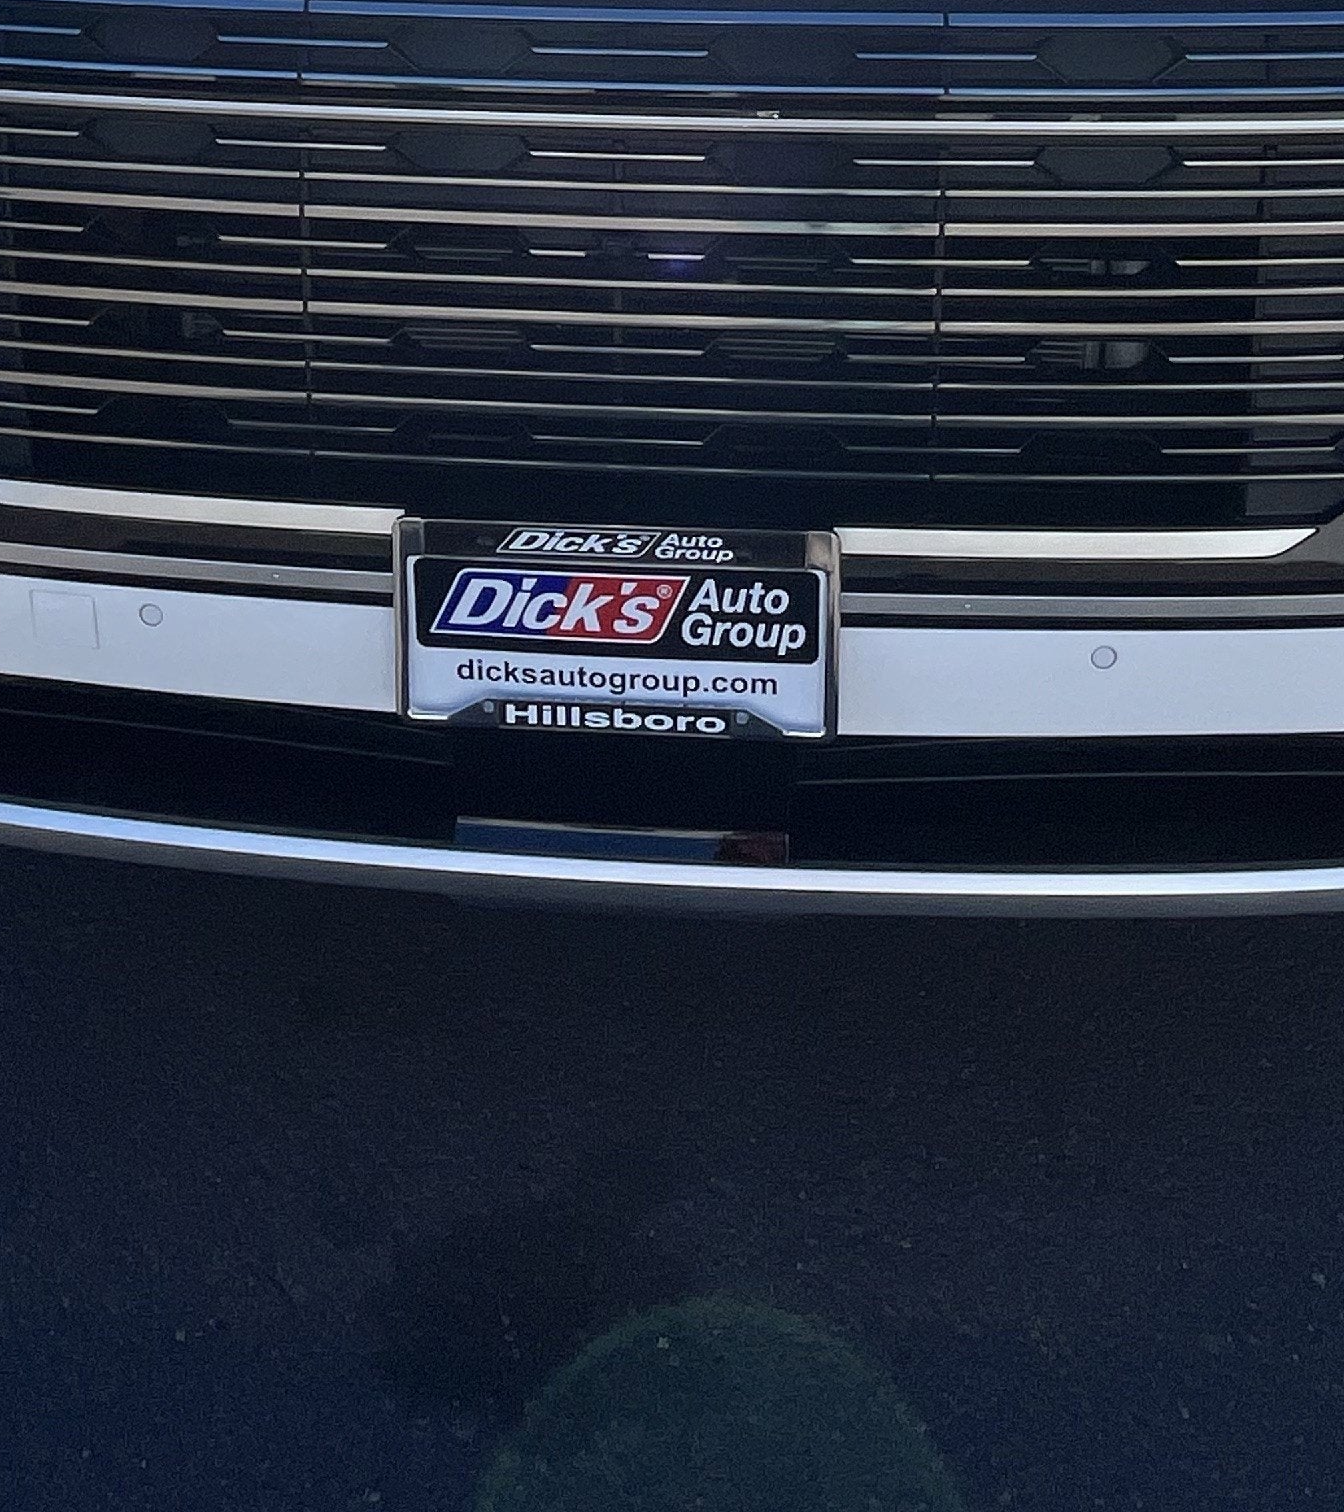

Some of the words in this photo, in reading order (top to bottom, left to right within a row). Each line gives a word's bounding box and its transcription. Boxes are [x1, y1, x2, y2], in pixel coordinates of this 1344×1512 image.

[655, 546, 734, 563] Group
[662, 533, 724, 549] Auto
[688, 578, 790, 615] Auto
[680, 612, 807, 656] Group
[456, 659, 779, 697] dicksautogroup.com
[504, 703, 726, 734] Hillsboro
